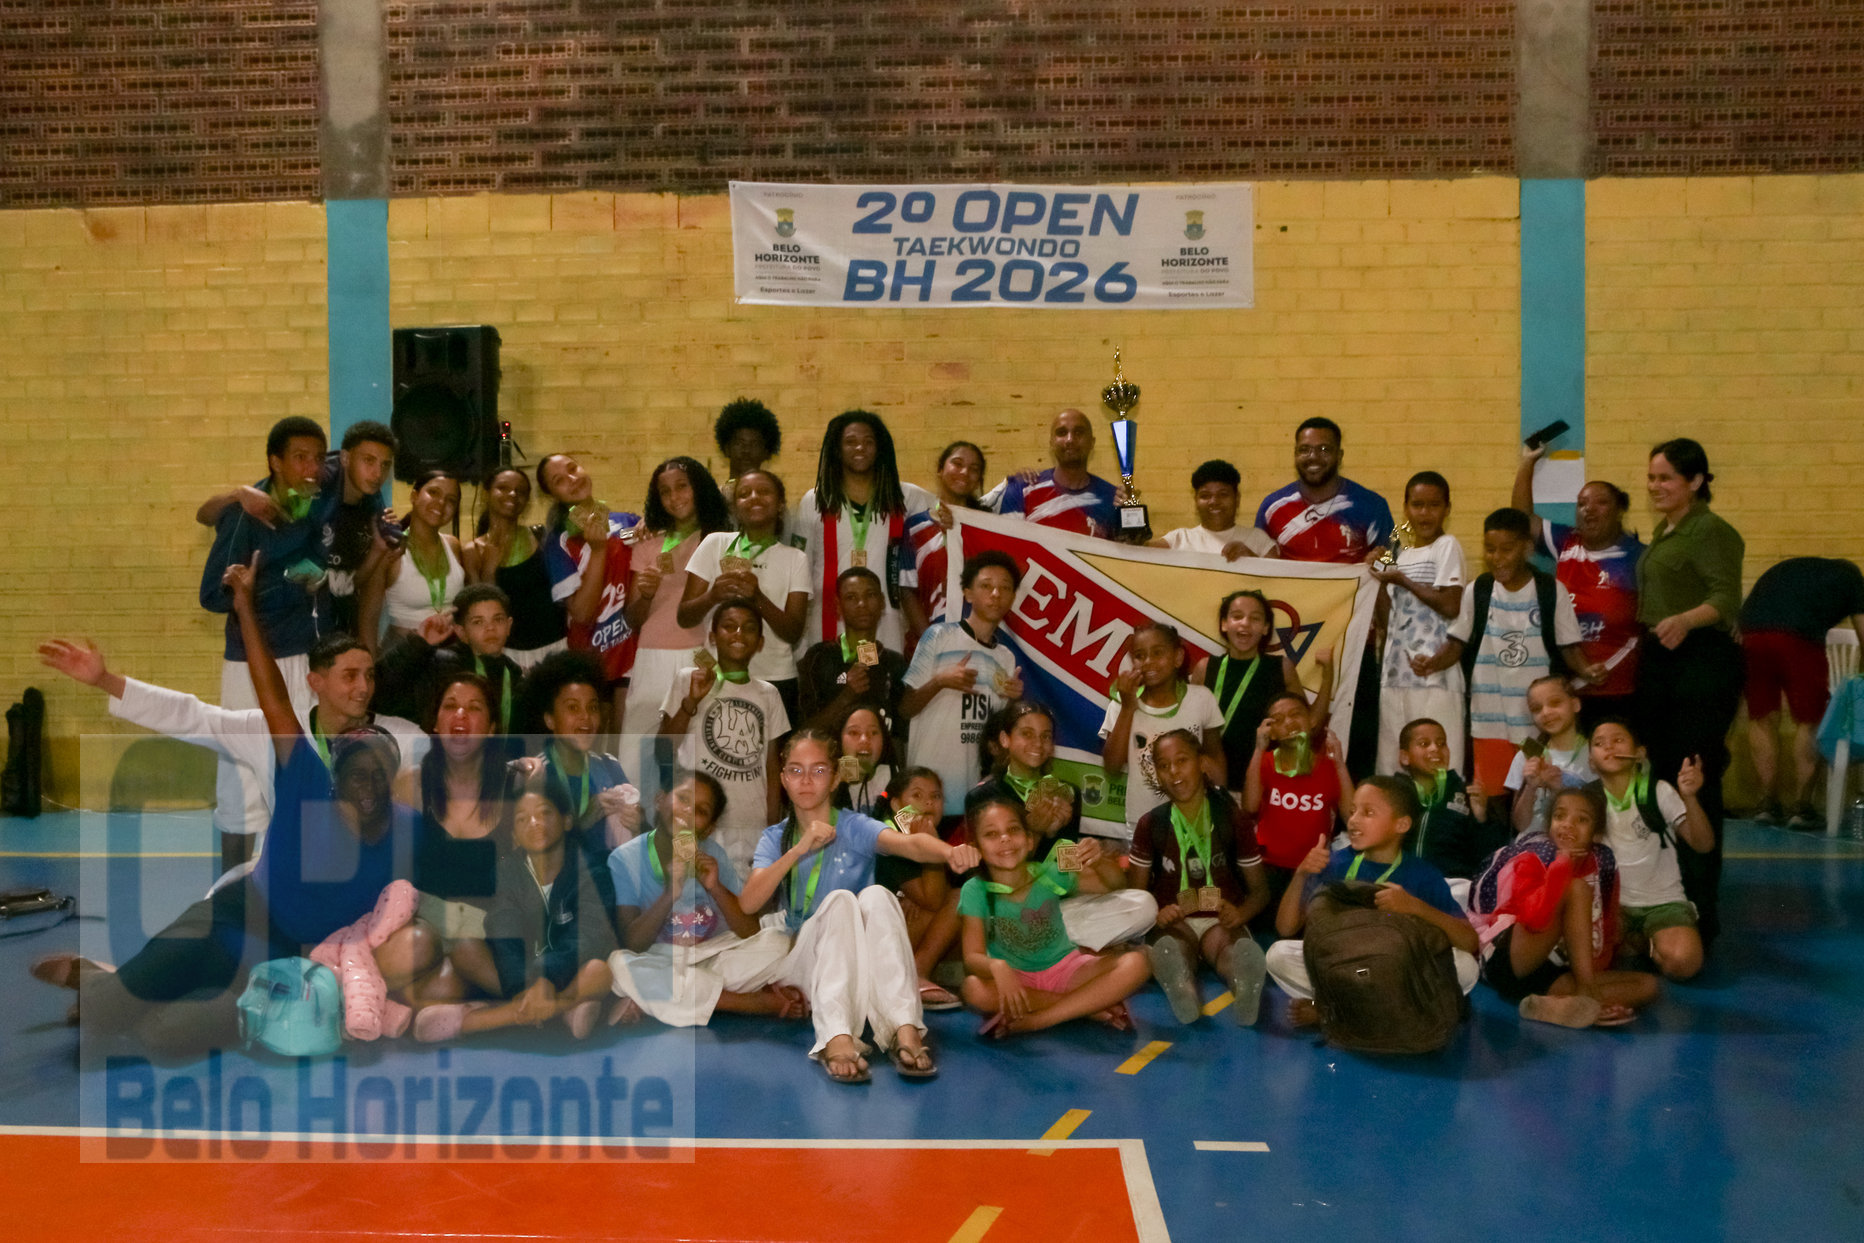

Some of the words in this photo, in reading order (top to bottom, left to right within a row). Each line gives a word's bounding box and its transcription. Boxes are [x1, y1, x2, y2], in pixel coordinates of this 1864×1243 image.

[852, 191, 936, 234] 2º
[952, 190, 1139, 237] OPEN
[773, 243, 801, 253] BELO
[893, 236, 1080, 258] TAEKWONDO
[1180, 246, 1209, 256] BELO
[755, 253, 820, 264] HORIZONTE
[1161, 257, 1229, 267] HORIZONTE
[843, 259, 937, 302] BH
[951, 259, 1138, 304] 2026
[1011, 556, 1134, 679] EM
[1269, 787, 1324, 812] BOSS
